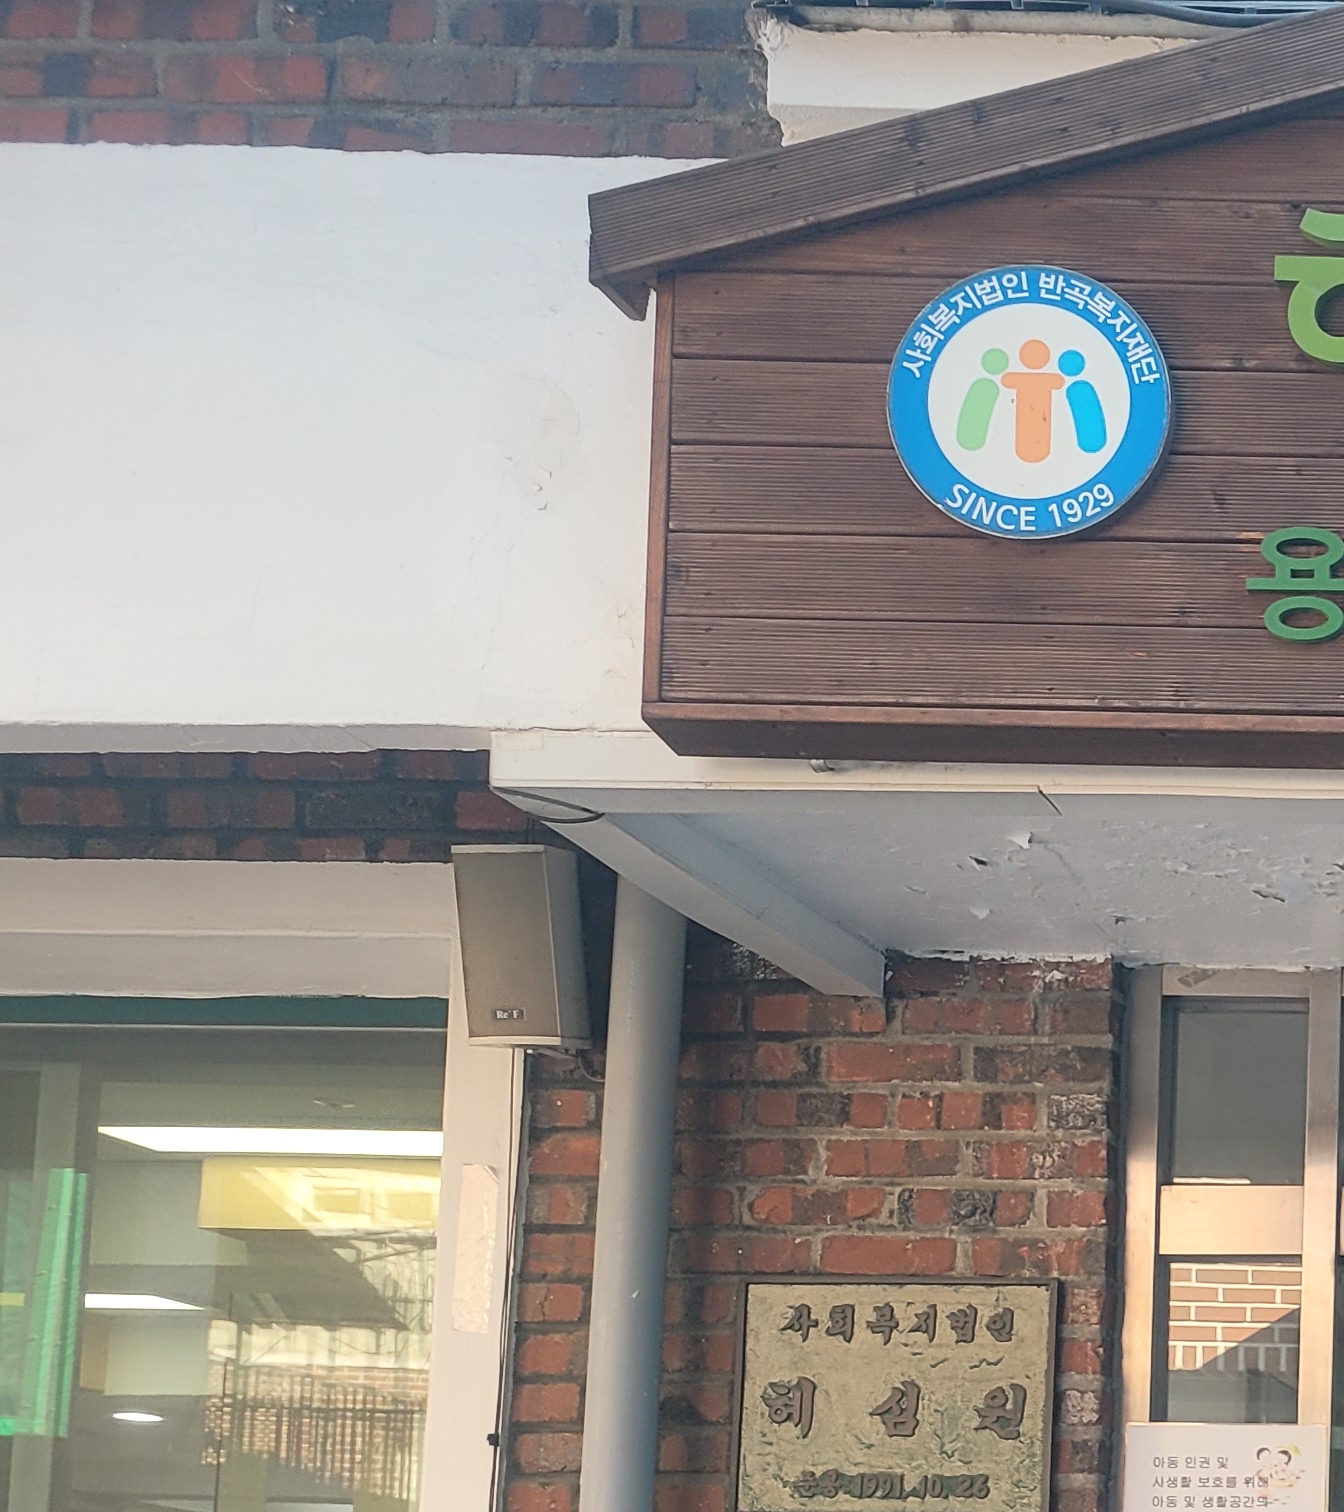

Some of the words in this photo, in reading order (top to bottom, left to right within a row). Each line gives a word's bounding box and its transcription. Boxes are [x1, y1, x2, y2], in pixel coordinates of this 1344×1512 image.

[902, 271, 1029, 379] 사회복지법인
[1038, 272, 1160, 385] 반곡복지재단
[944, 484, 1037, 530] SINCE
[1048, 484, 1115, 530] 1929
[780, 1303, 1014, 1345] 사회복지법인
[1153, 1456, 1179, 1469] 아동
[1185, 1456, 1211, 1469] 인권
[1217, 1456, 1229, 1469] 및
[954, 1471, 990, 1499] 26
[1152, 1476, 1192, 1488] 사생활
[1198, 1476, 1237, 1488] 보호를
[1243, 1476, 1269, 1488] 위해
[1152, 1495, 1178, 1508] 아동
[1184, 1495, 1196, 1508] 및
[1202, 1495, 1268, 1508] 생활공간의
